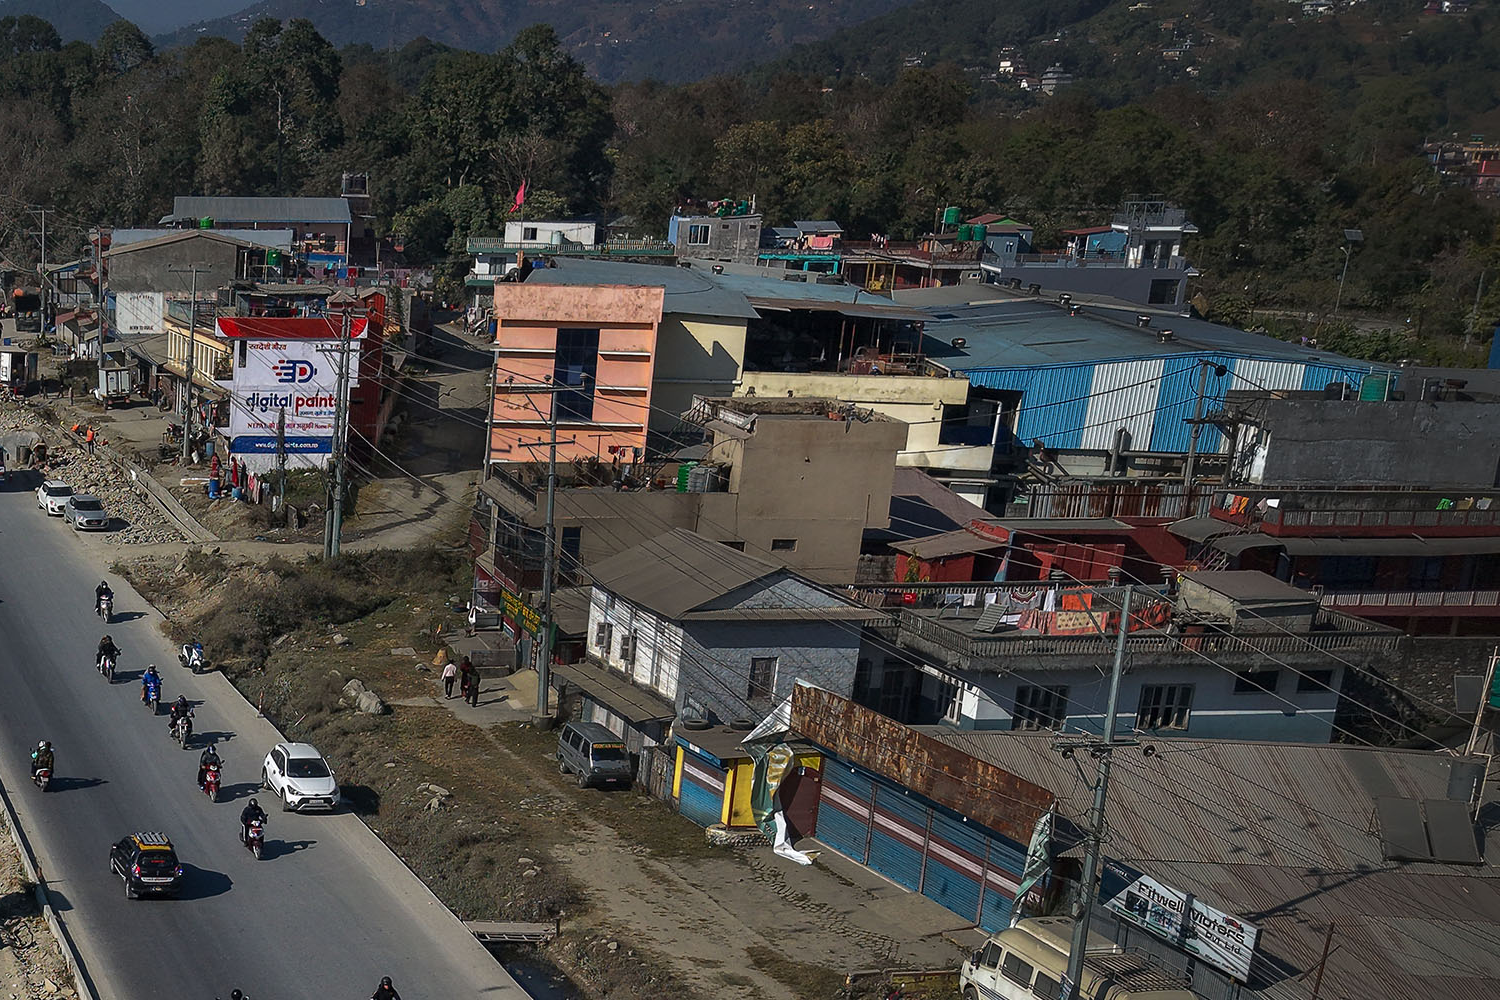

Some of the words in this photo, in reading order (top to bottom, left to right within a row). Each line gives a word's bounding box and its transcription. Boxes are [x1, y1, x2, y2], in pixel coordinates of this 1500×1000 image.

[246, 392, 292, 413] digital
[1138, 881, 1185, 914] Fitwell
[1189, 907, 1245, 944] Motors
